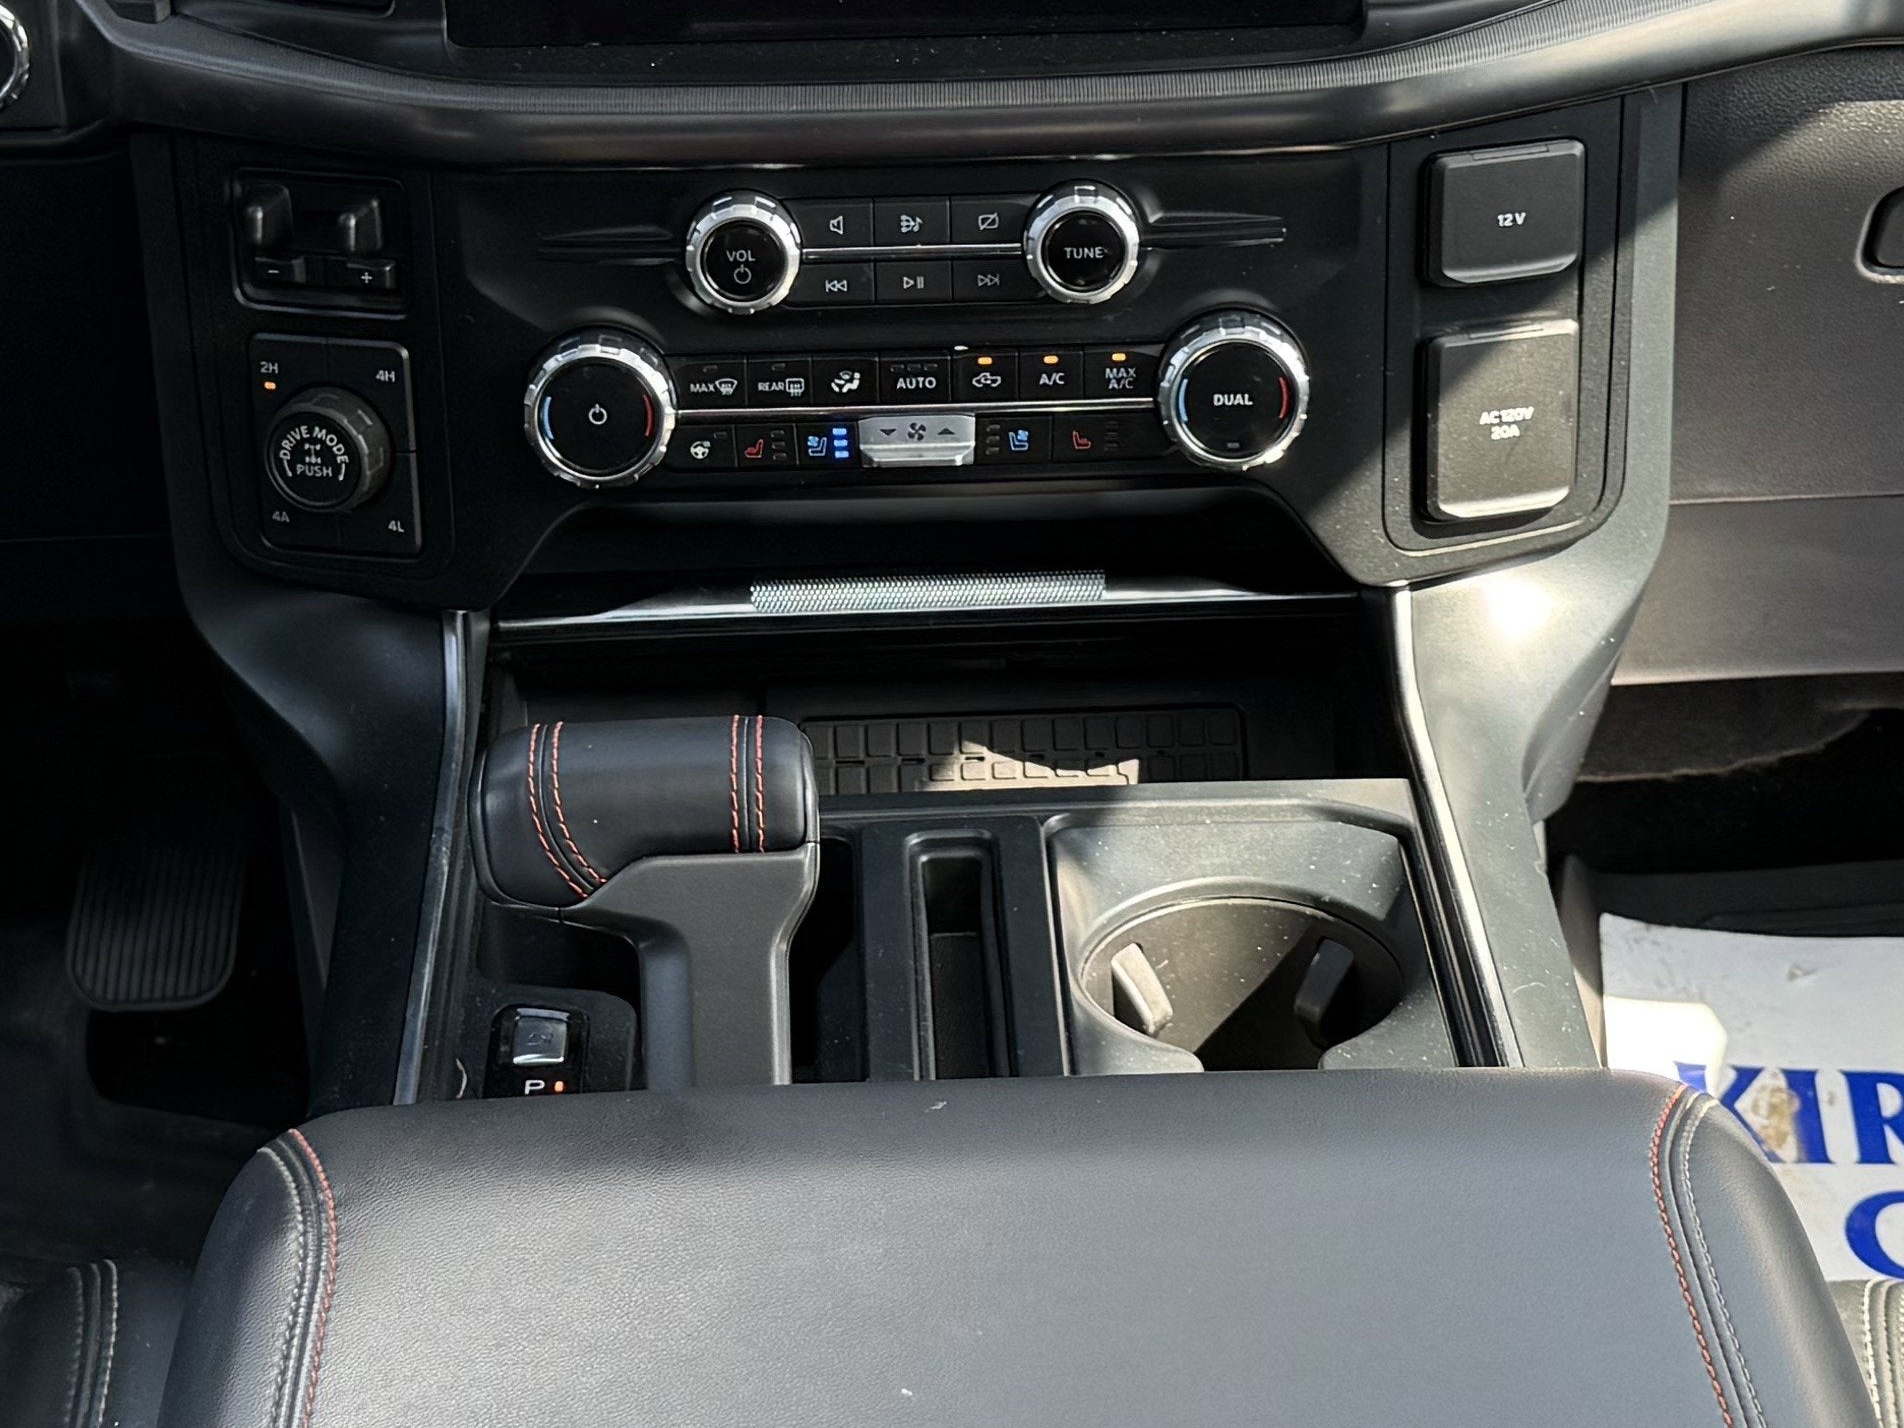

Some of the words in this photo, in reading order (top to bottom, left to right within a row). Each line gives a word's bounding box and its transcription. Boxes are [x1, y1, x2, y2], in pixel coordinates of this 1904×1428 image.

[727, 249, 755, 262] VOL
[1065, 246, 1104, 259] TUNE
[260, 361, 279, 374] 2H
[1105, 368, 1136, 380] MAX
[375, 370, 396, 382] 4H
[1039, 372, 1065, 386] A/C
[690, 382, 715, 393] MAX
[758, 381, 784, 392] REAR
[897, 377, 936, 389] AUTO
[1108, 379, 1134, 390] A/C
[1213, 393, 1253, 406] DUAL
[279, 425, 309, 460] DRIVE
[312, 426, 349, 464] MODE
[296, 464, 332, 478] PUSH
[272, 510, 290, 523] 4A
[388, 519, 404, 533] 4L
[525, 1080, 545, 1095] P
